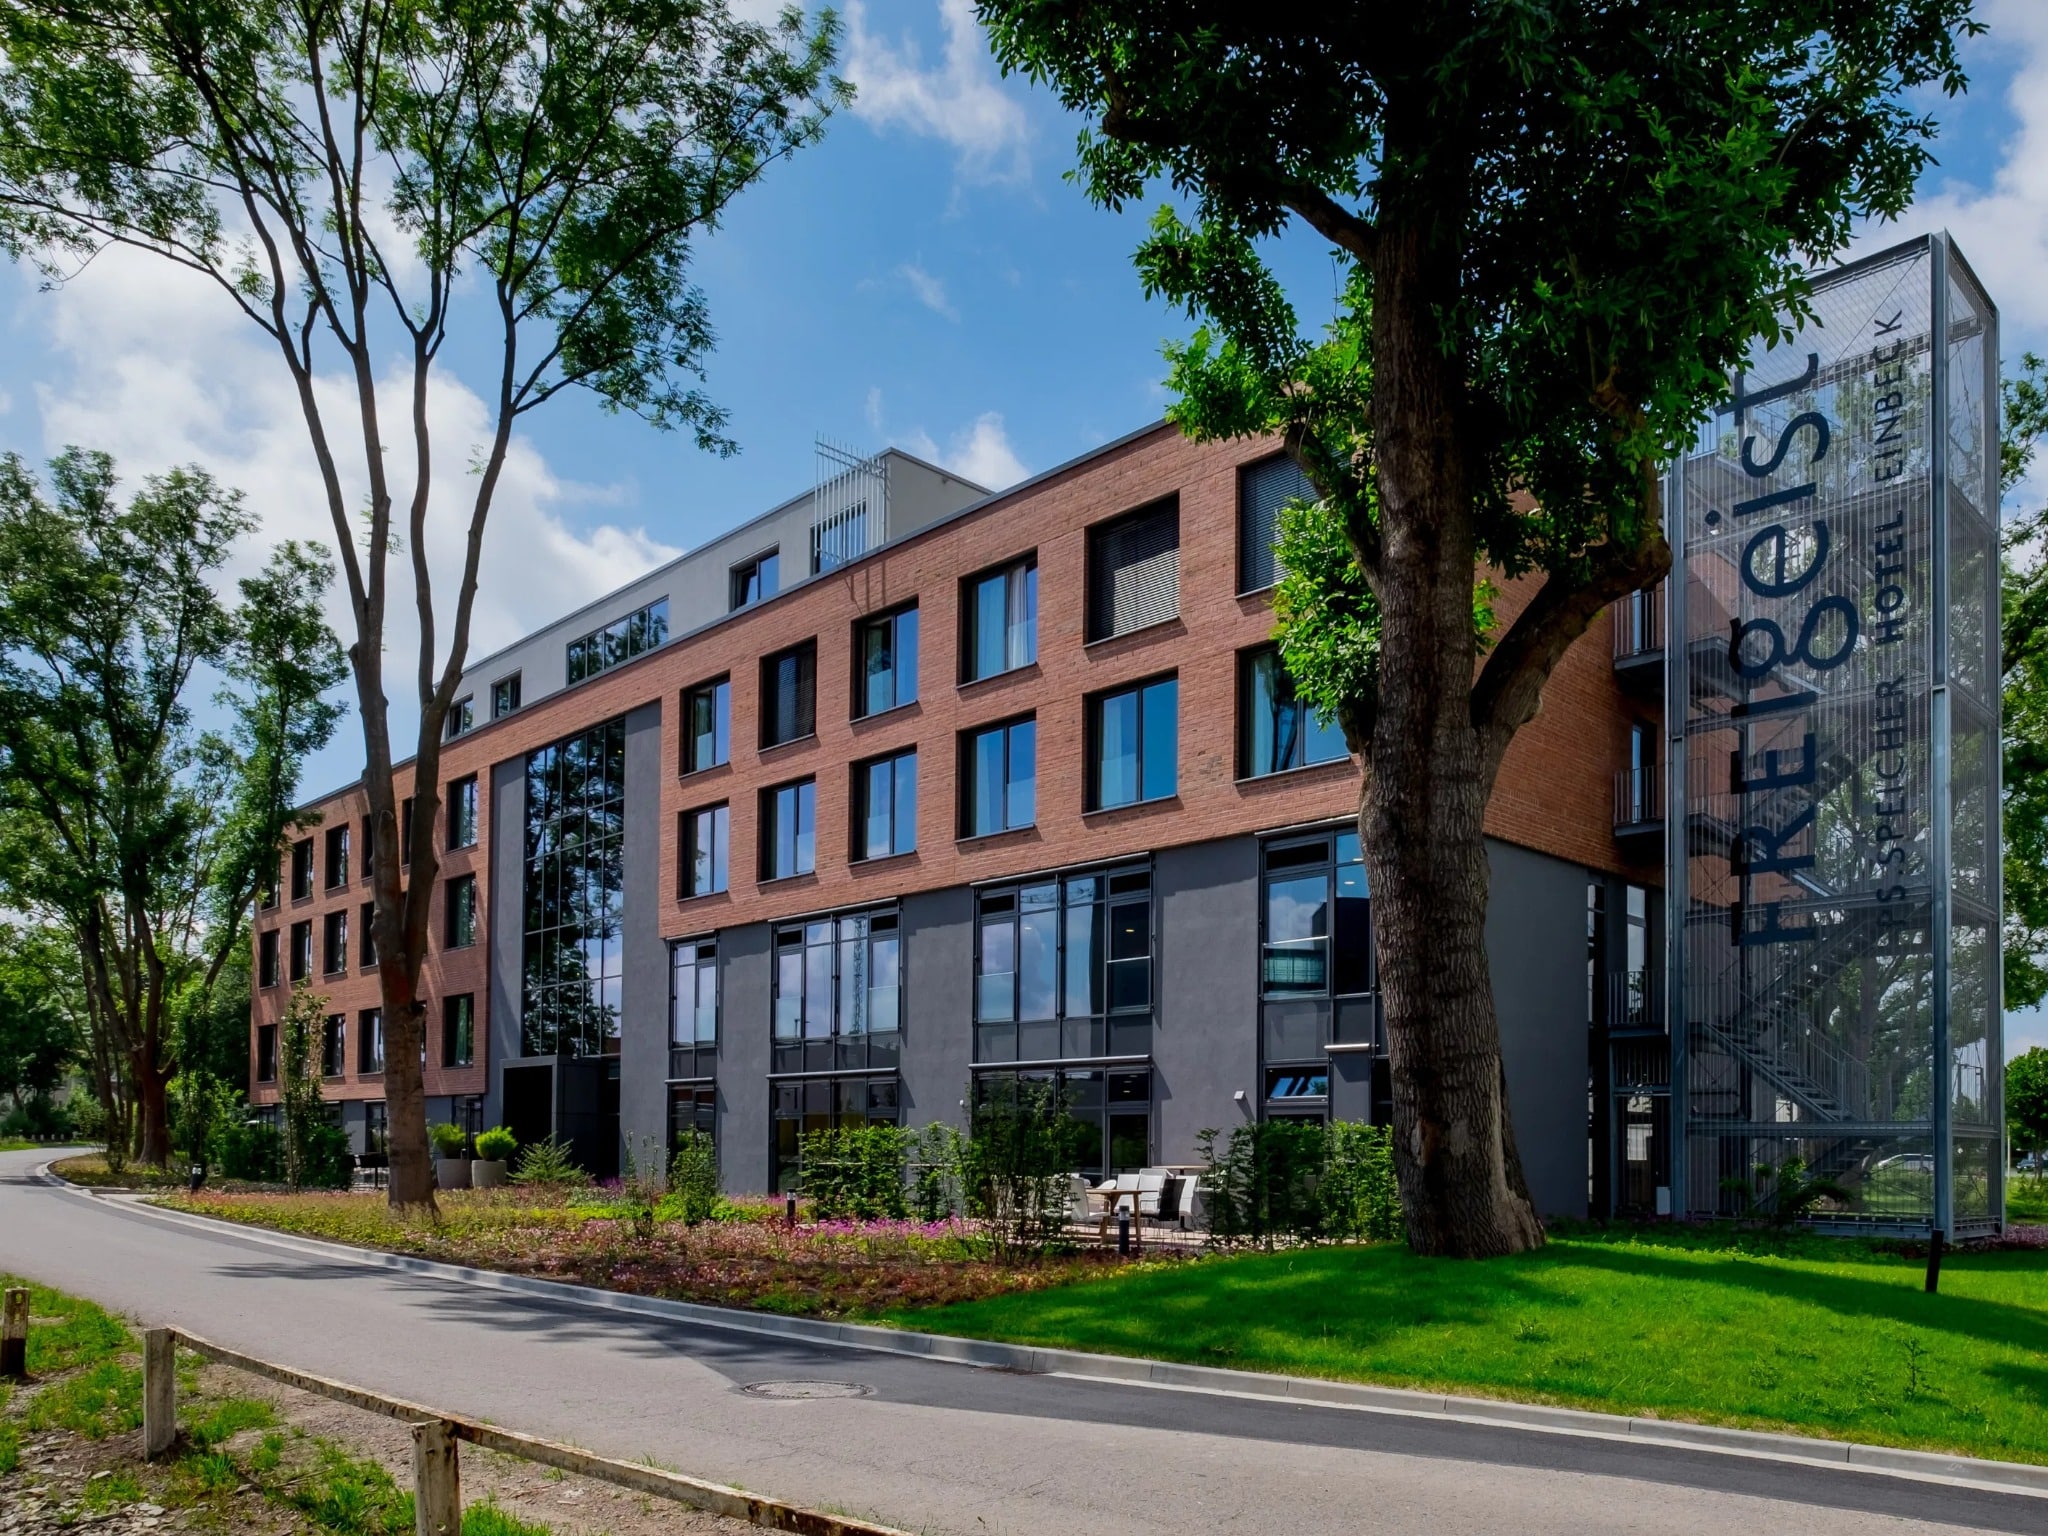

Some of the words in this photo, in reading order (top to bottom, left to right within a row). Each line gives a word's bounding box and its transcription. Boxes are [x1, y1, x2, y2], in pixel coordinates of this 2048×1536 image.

[1873, 310, 1903, 482] EINBECK
[1704, 353, 1859, 946] FREIgeist
[1874, 510, 1904, 644] HOTEL
